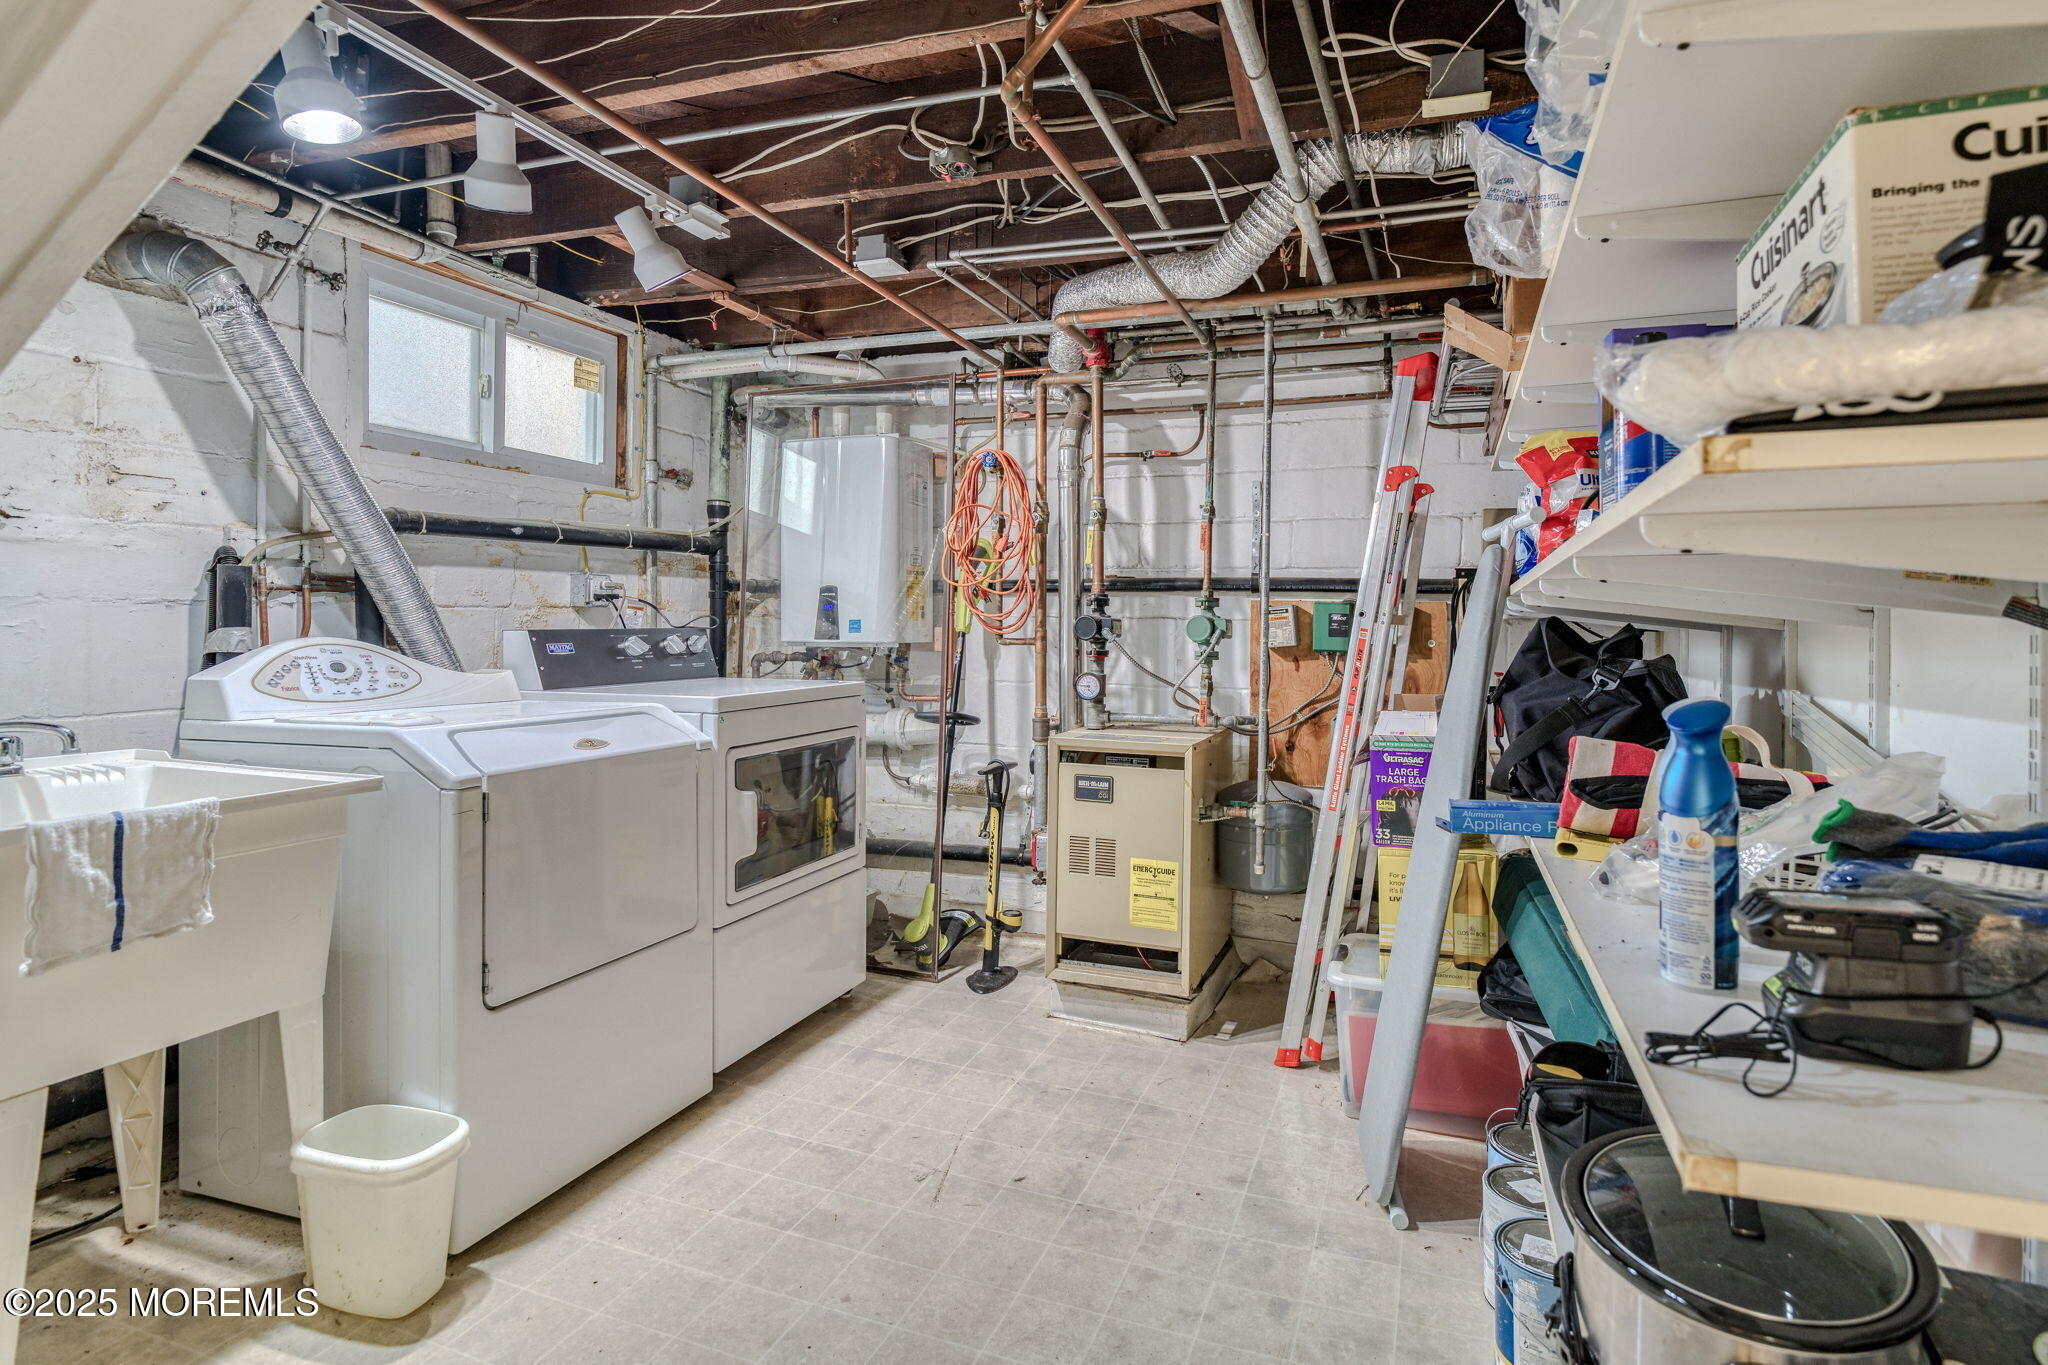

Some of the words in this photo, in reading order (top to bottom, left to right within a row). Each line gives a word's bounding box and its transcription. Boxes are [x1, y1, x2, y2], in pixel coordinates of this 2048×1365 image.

[1872, 181, 1945, 198] Bringing
[1952, 178, 1980, 190] the
[1751, 177, 1827, 290] Cuisinart
[1388, 768, 1420, 777] LARGE
[1376, 775, 1406, 784] TRASH
[1462, 810, 1504, 819] Aluminum
[1463, 818, 1541, 832] Appliance
[1375, 828, 1391, 839] 33
